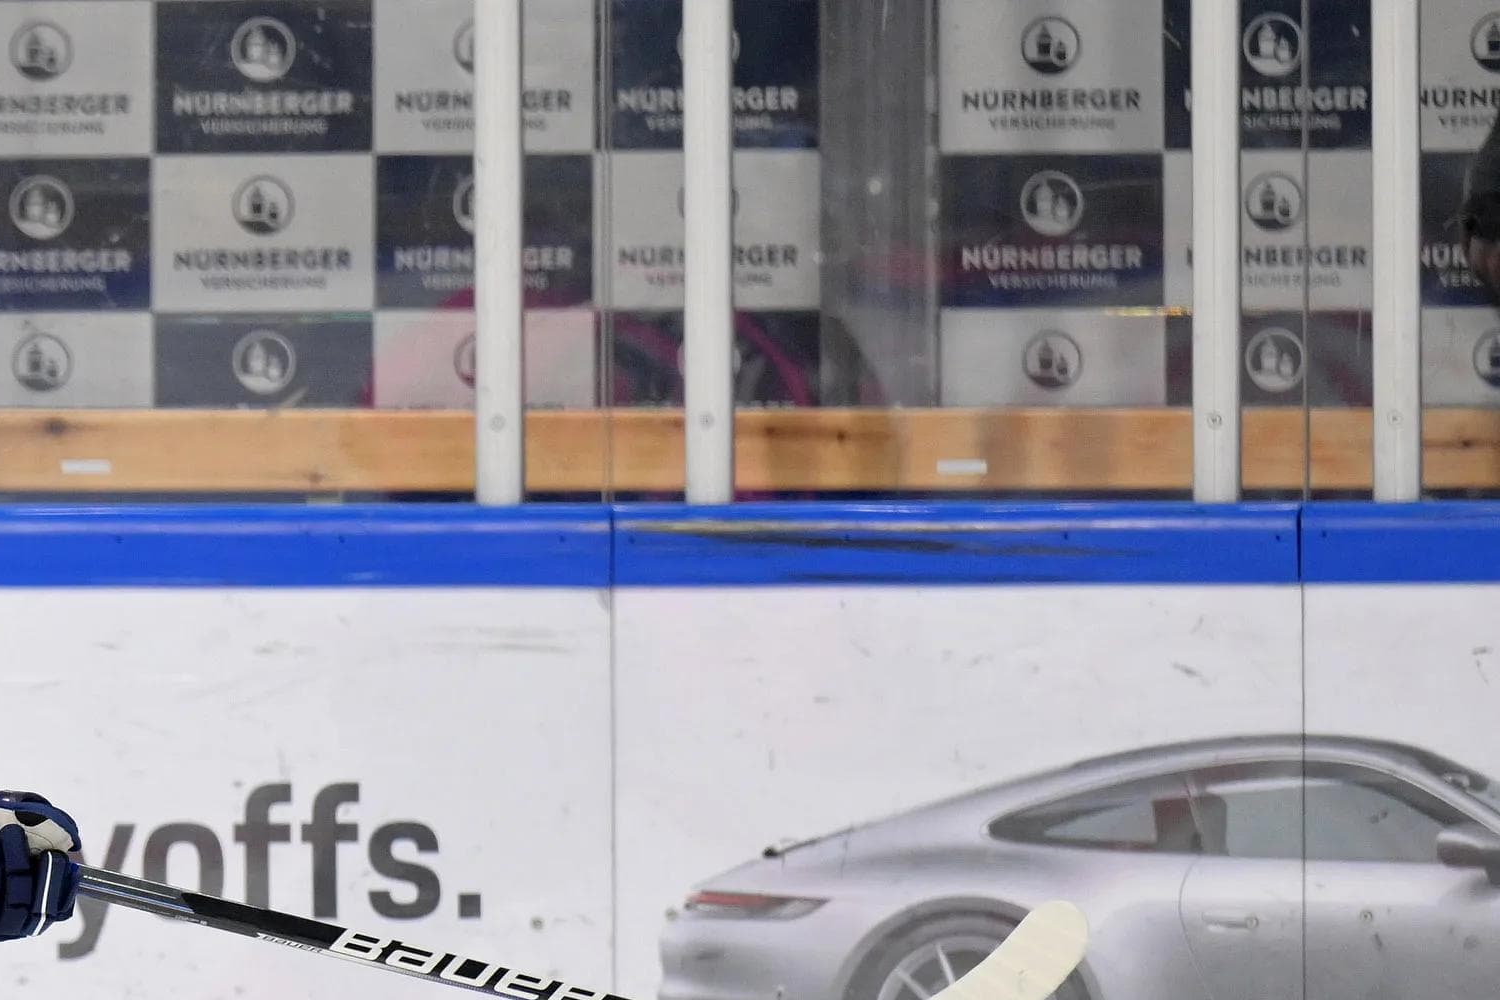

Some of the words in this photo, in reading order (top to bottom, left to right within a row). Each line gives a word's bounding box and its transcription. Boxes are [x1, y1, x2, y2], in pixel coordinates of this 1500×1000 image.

[963, 87, 1141, 111] NÜRNBERGER
[1184, 86, 1367, 112] NBERGER
[173, 247, 353, 272] NÜRNBERGER
[962, 244, 1143, 271] NÜRNBERGER
[56, 781, 482, 961] yoffs.
